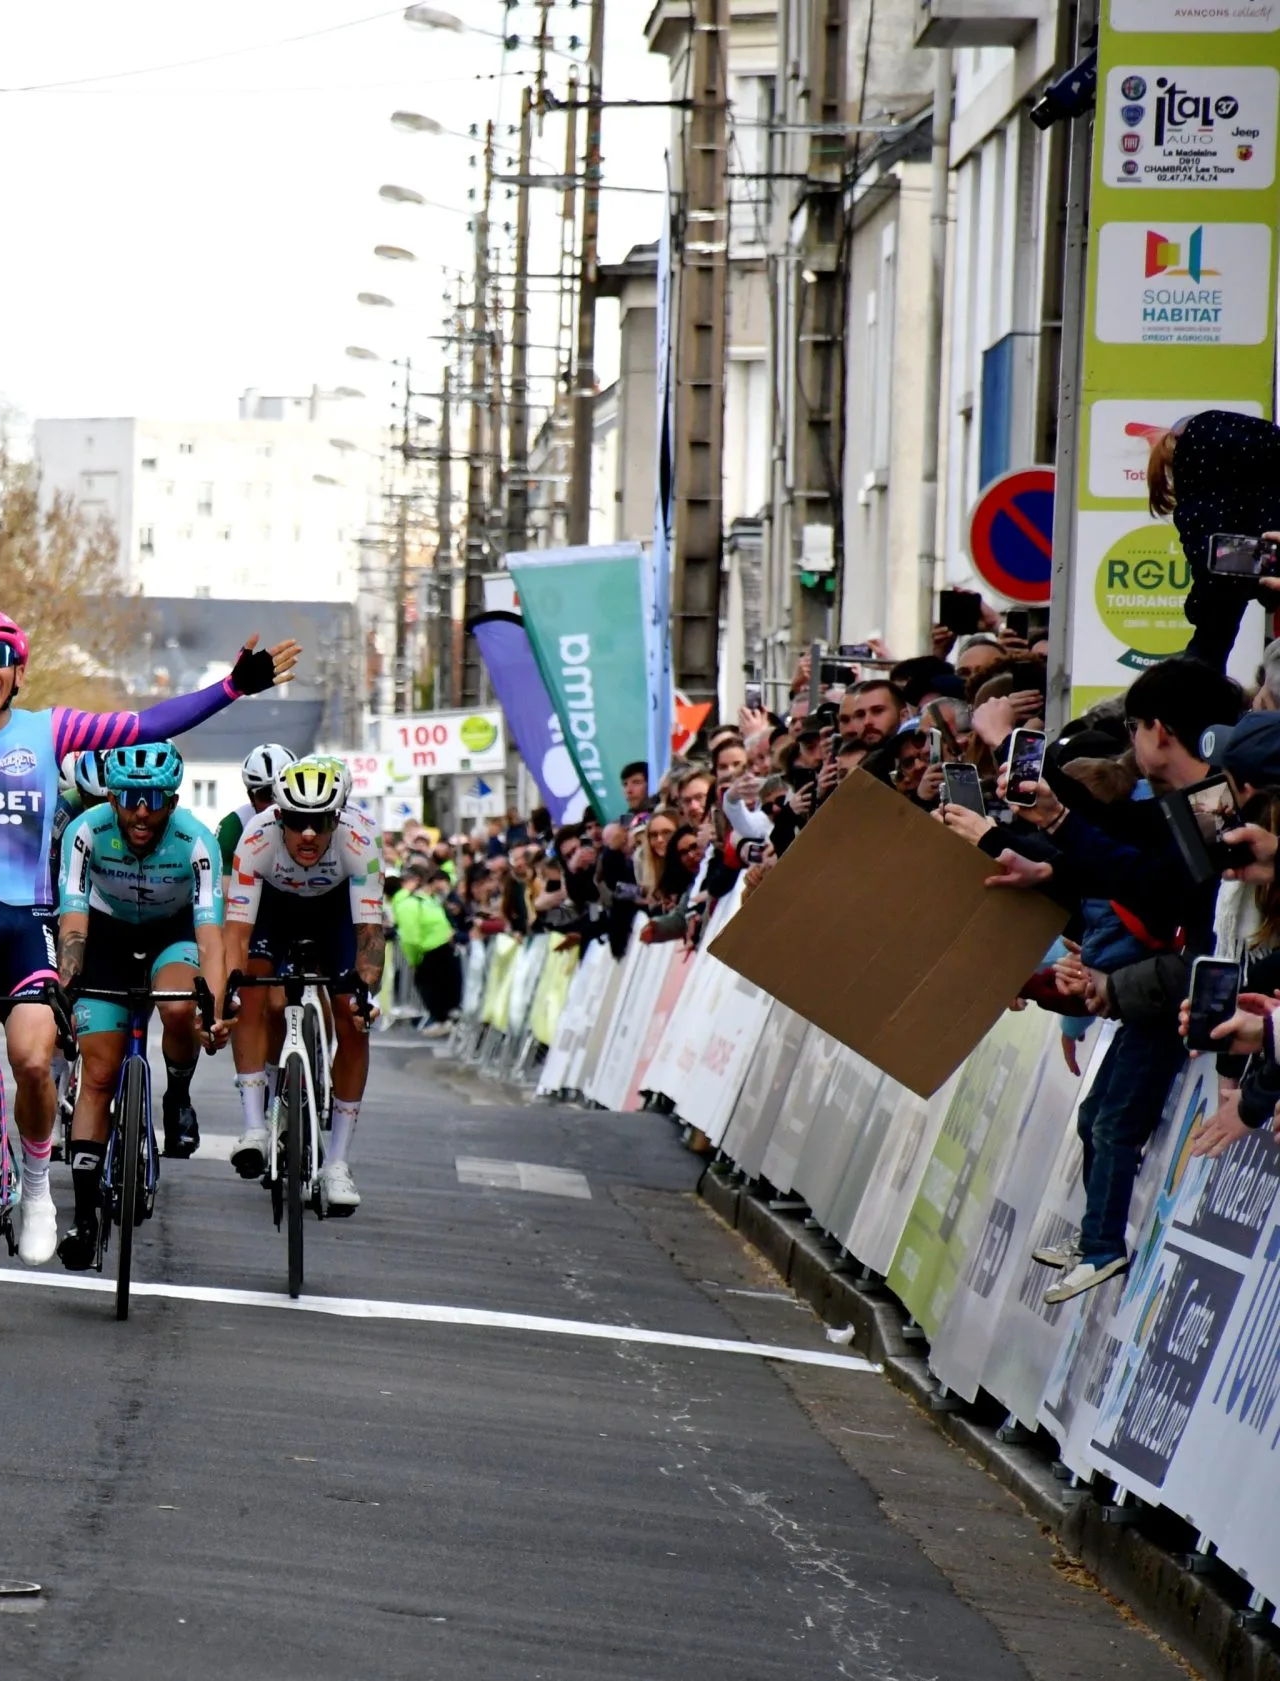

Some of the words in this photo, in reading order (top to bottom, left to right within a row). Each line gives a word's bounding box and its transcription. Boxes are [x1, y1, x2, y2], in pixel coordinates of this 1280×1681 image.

[1167, 135, 1213, 144] AUTO
[1231, 127, 1259, 139] Jeep
[1144, 165, 1193, 173] CHAMBRAY
[1143, 290, 1222, 305] SQUARE
[1143, 308, 1222, 322] HABITAT
[1123, 470, 1146, 481] Tot
[1106, 594, 1186, 608] TOURANGE
[399, 725, 448, 747] 100
[413, 752, 436, 767] m
[1168, 1278, 1215, 1365] Centre-
